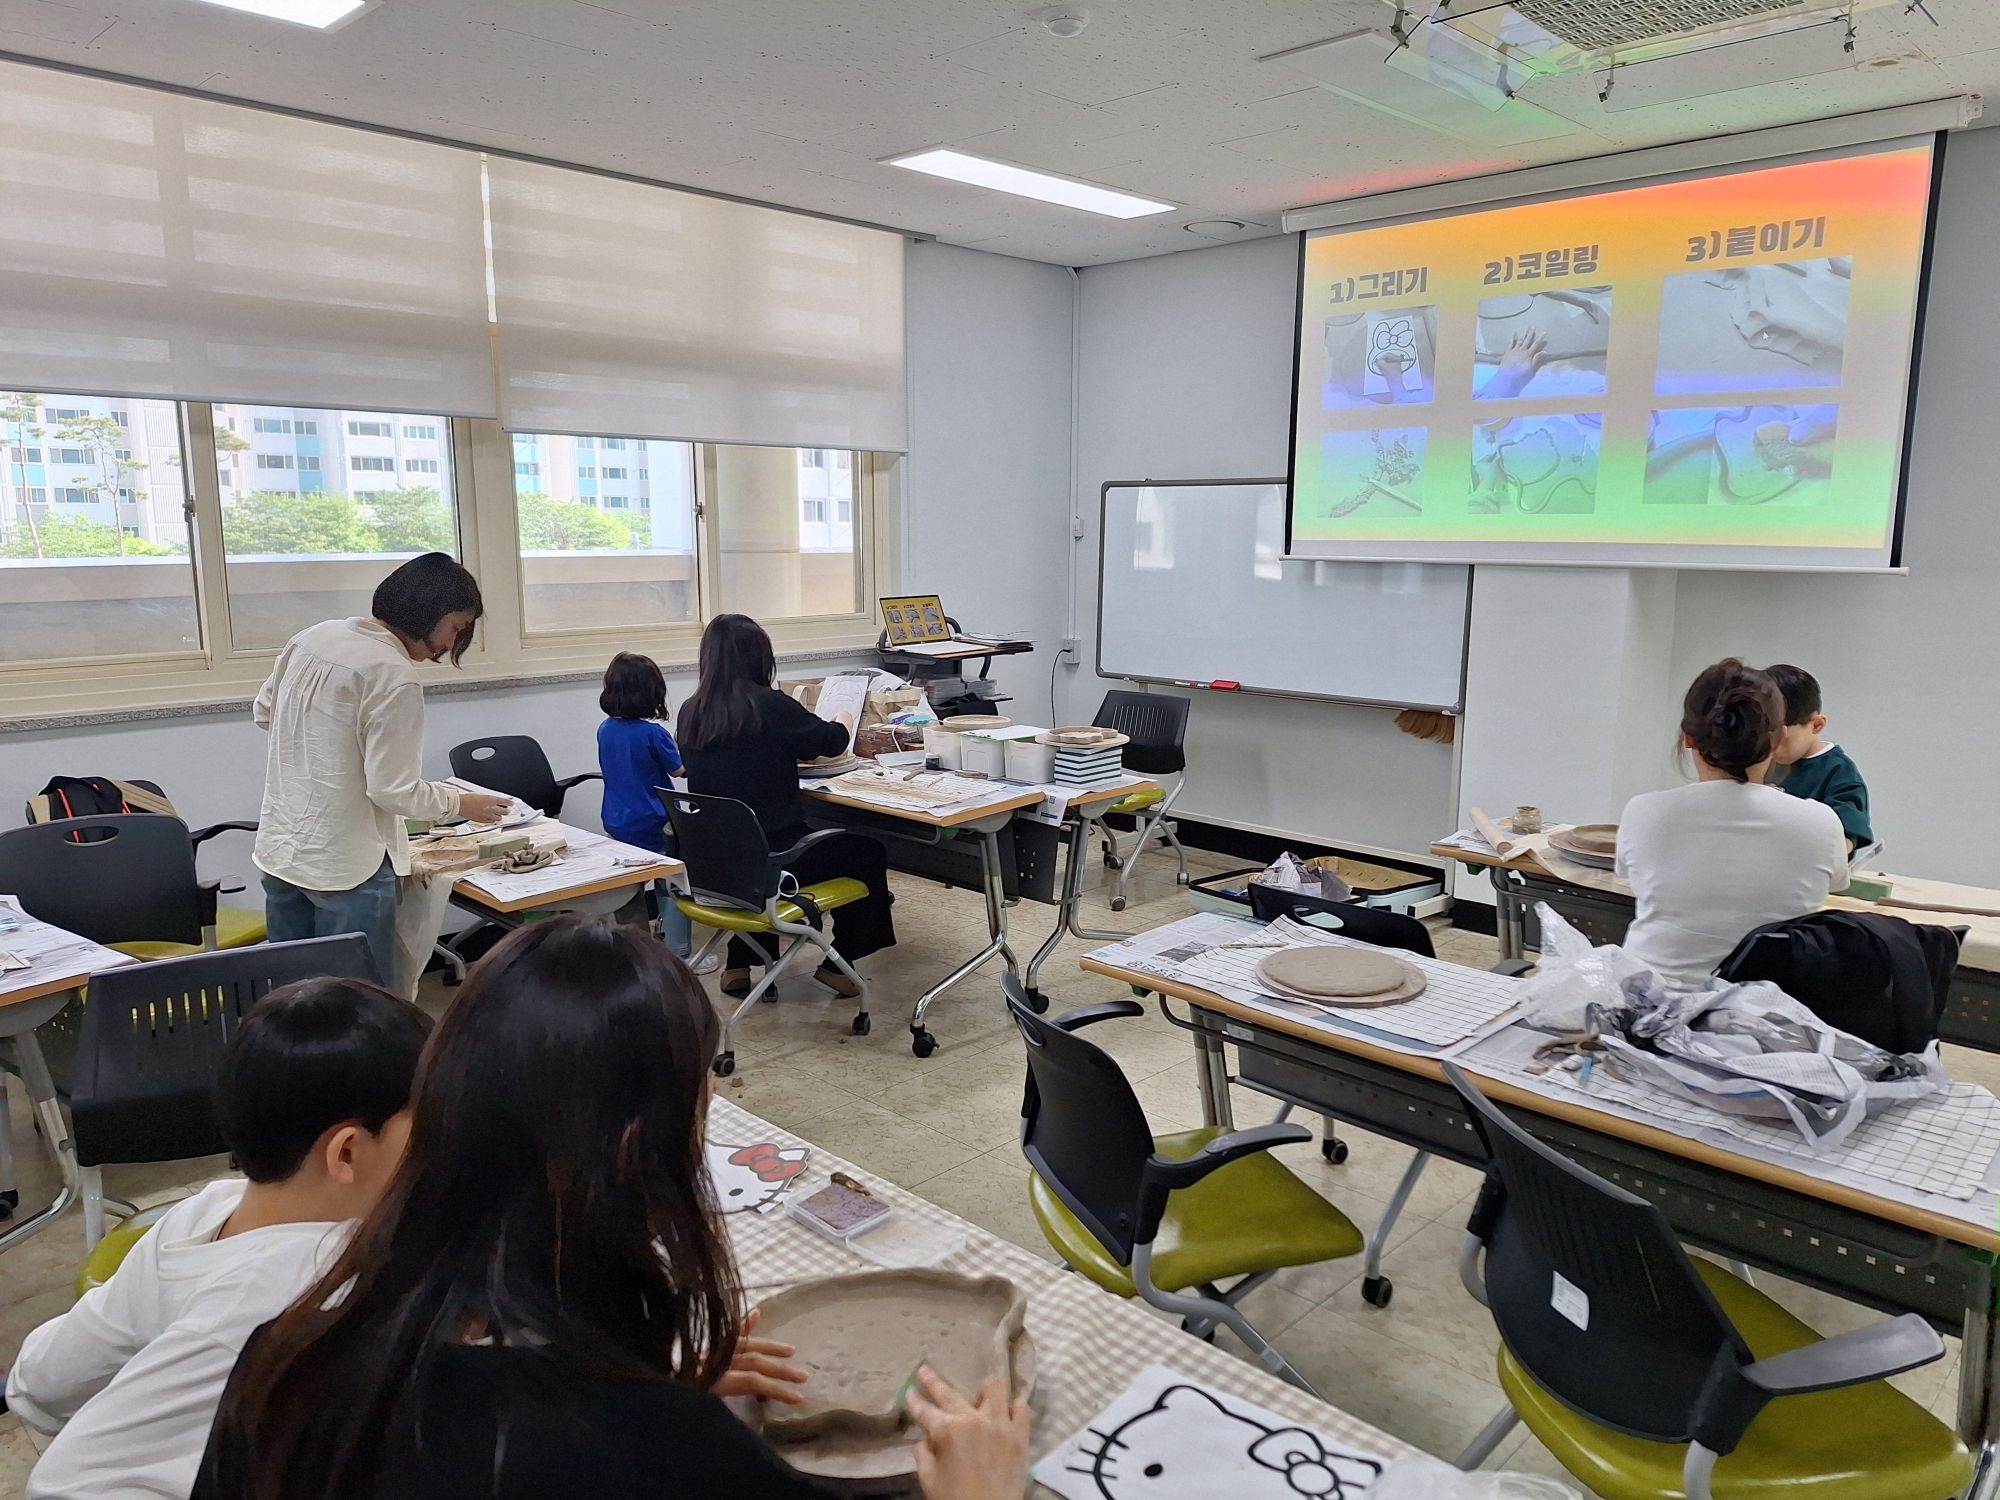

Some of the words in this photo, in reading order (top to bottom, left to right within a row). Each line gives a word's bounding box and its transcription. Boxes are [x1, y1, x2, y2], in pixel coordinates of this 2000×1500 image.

[1686, 216, 1826, 262] 3)붙이기
[1330, 267, 1427, 303] 1)그리기
[1484, 245, 1599, 285] 2)코일링
